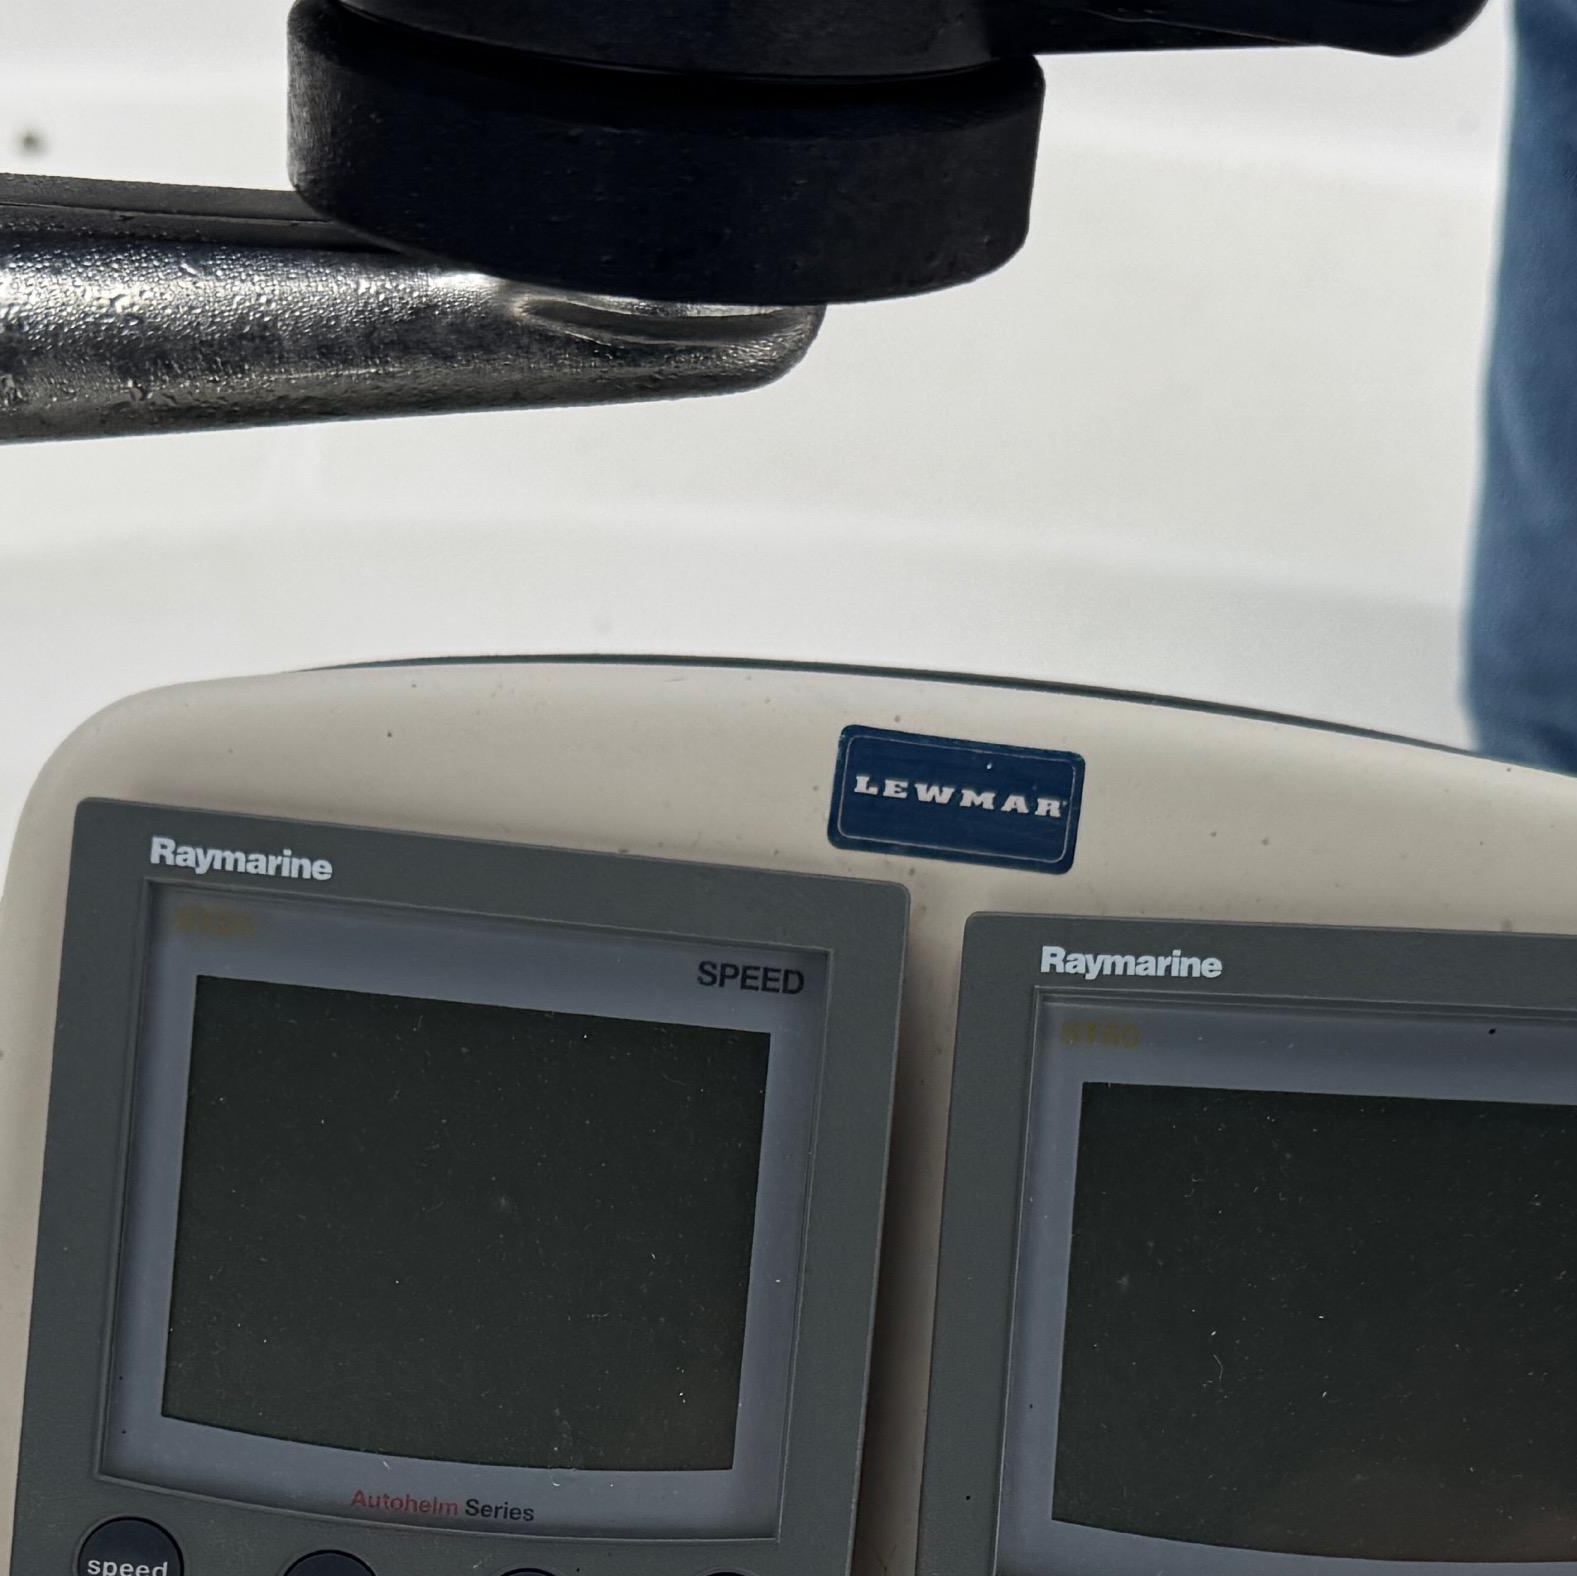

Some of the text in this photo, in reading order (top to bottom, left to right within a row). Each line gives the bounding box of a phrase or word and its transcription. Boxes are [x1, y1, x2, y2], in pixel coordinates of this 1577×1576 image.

[853, 775, 1062, 818] LEWMAR
[150, 836, 334, 881] Raymarine
[696, 960, 806, 996] SPEED
[1040, 945, 1223, 980] Raymarine
[351, 1489, 536, 1525] Autohelm Series
